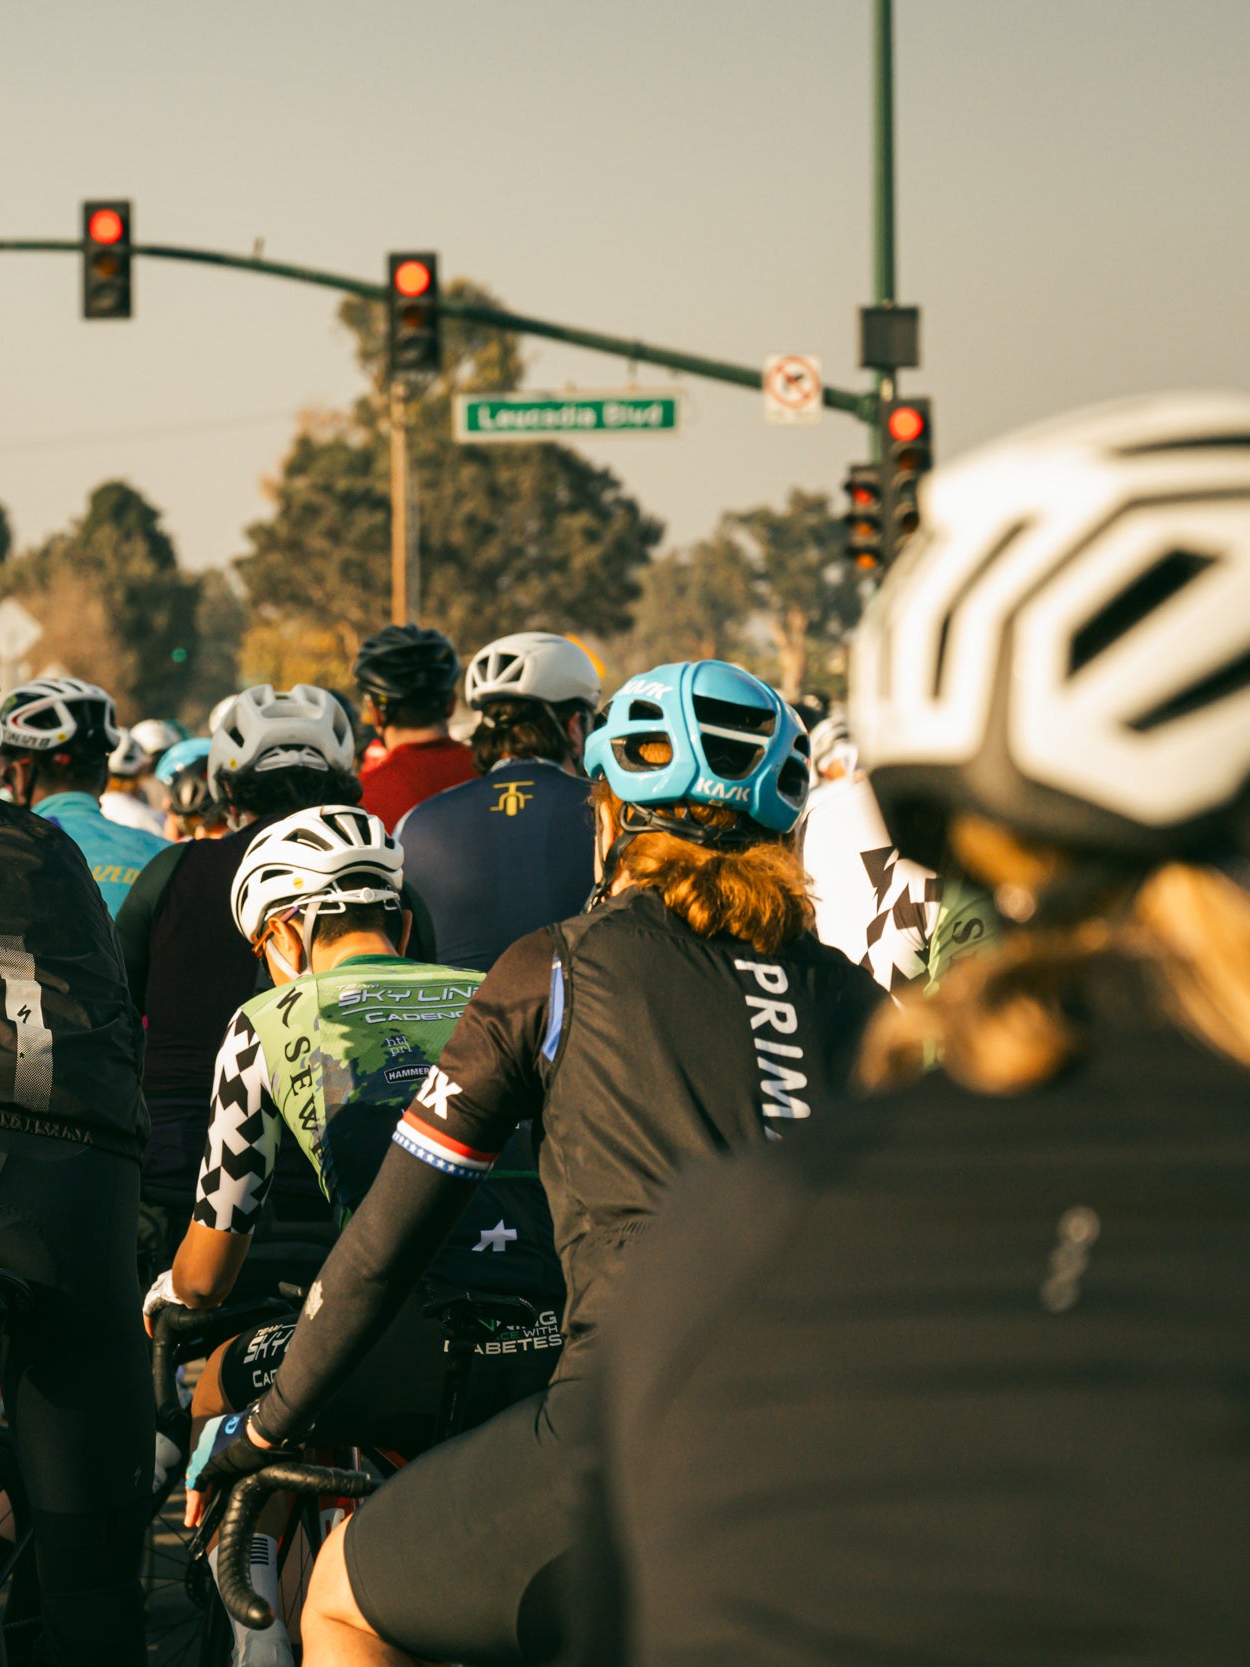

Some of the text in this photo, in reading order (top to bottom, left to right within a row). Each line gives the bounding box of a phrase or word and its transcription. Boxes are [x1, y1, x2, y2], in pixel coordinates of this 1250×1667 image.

[478, 401, 664, 430] Leucadia Blvd
[695, 777, 751, 802] KASK
[734, 959, 811, 1142] PRIM
[523, 1325, 558, 1338] WITH
